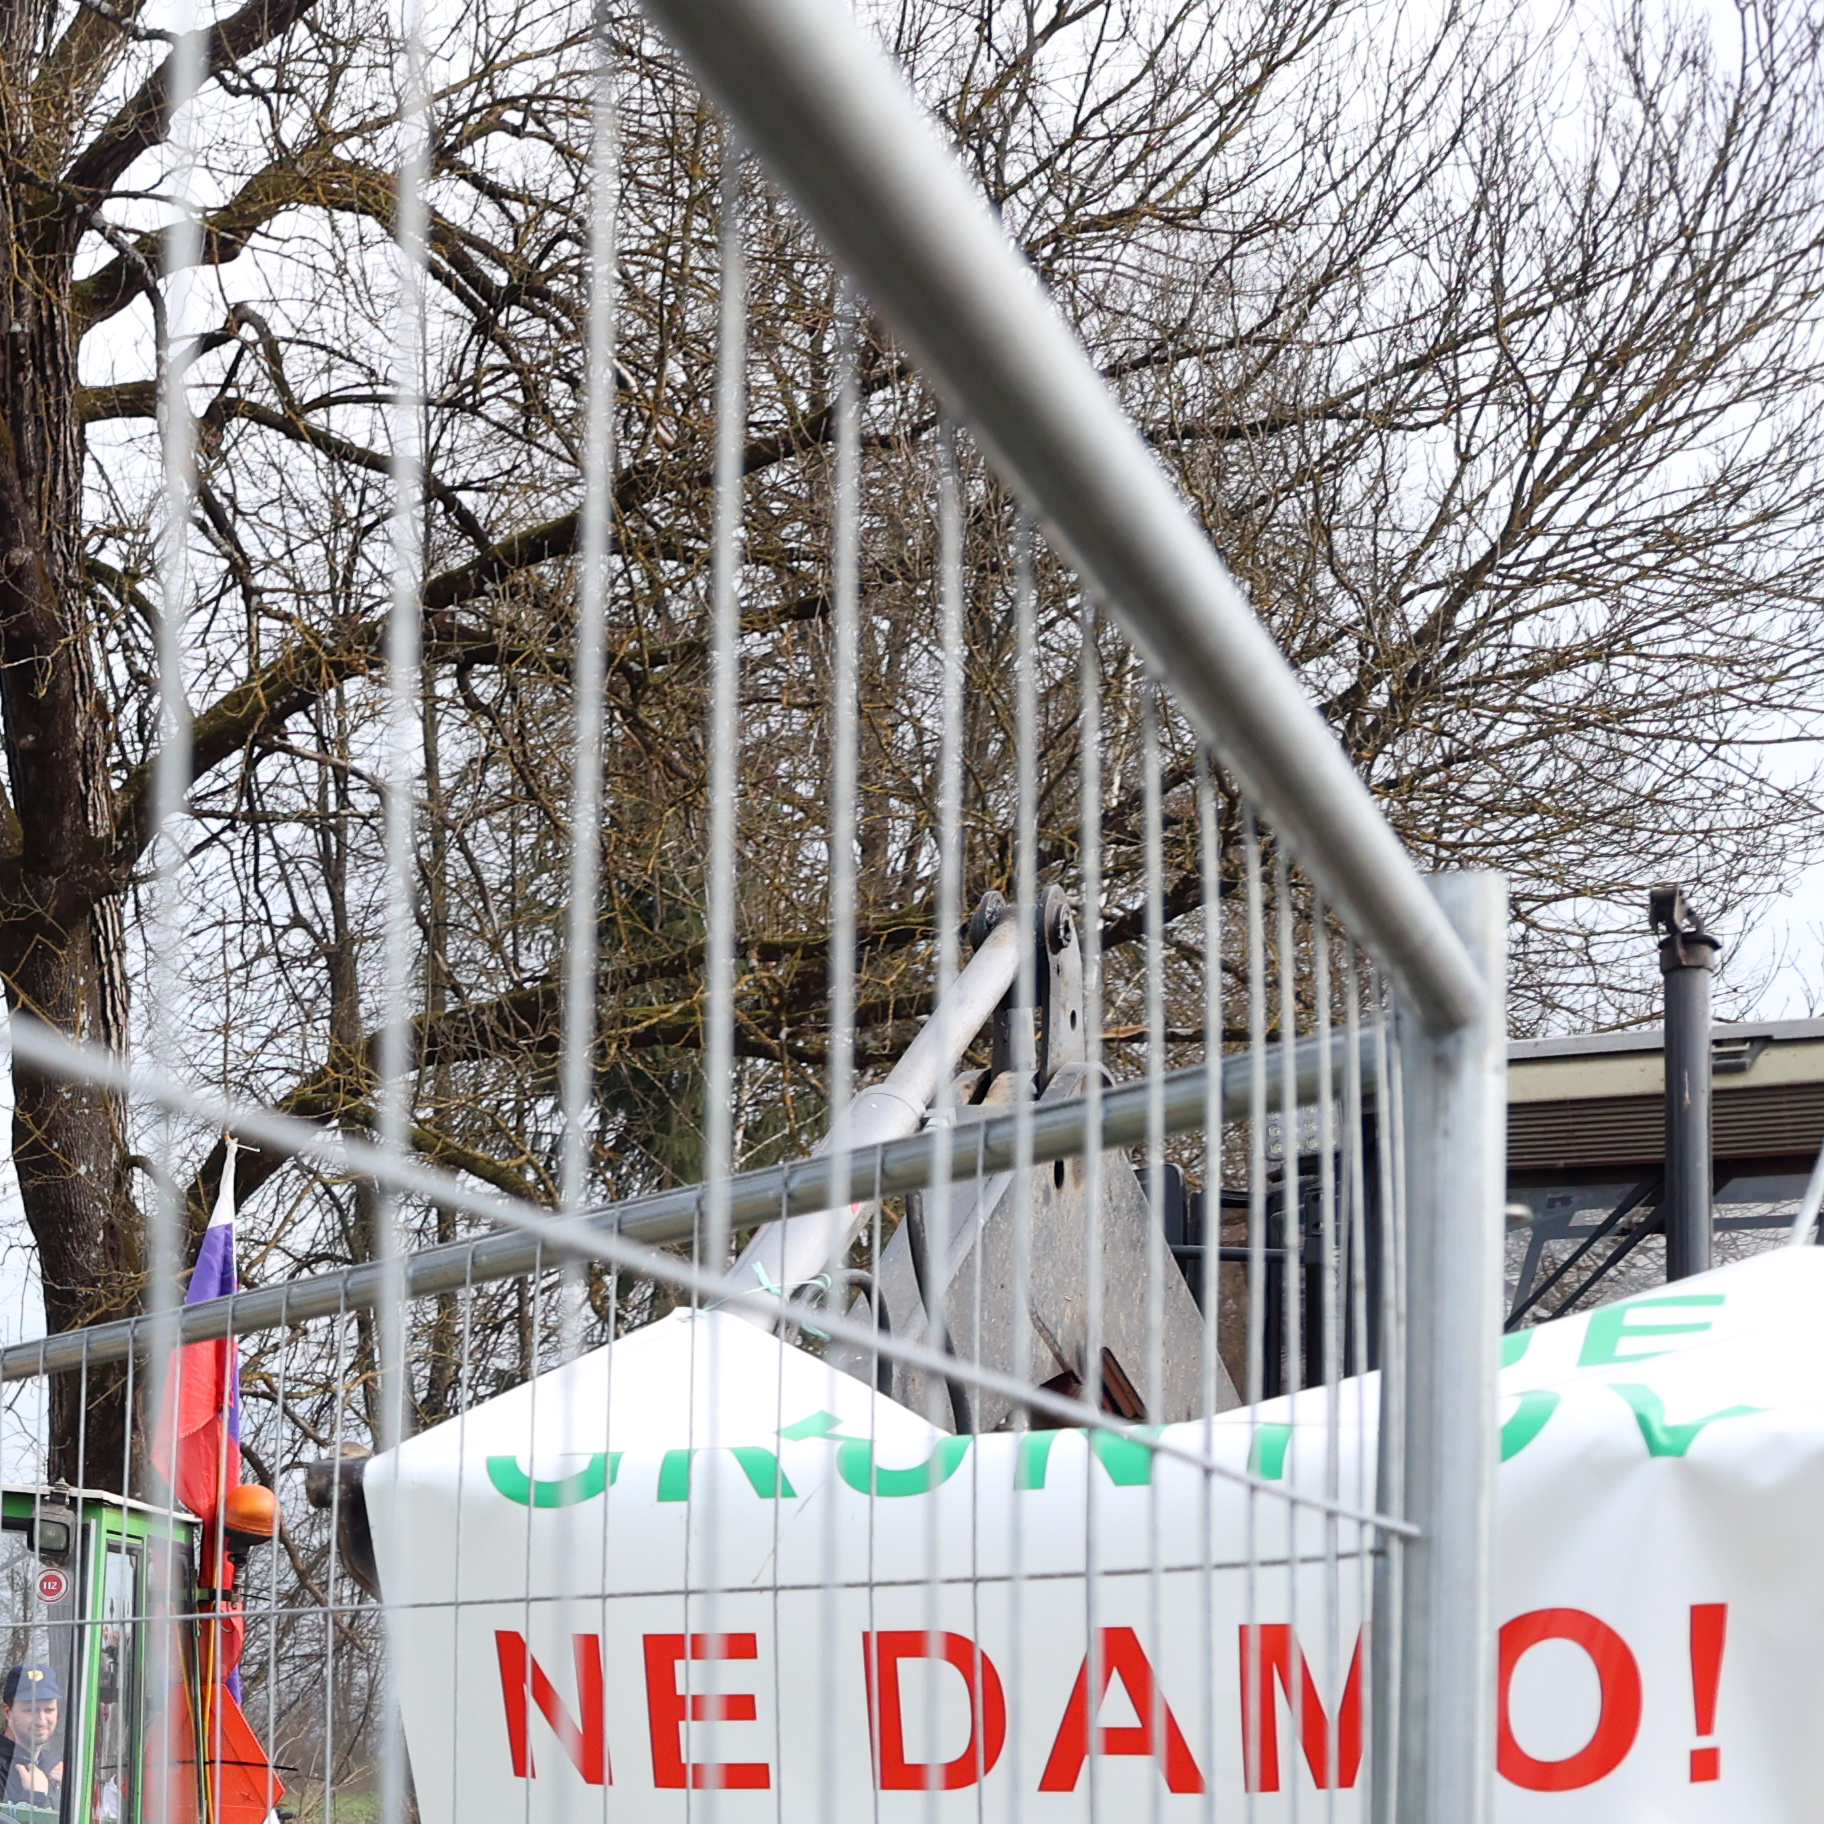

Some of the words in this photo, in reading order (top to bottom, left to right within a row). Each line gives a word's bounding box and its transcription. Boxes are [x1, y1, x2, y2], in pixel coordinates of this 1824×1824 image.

[42, 1581, 58, 1590] 112
[494, 1629, 772, 1791] NE
[861, 1602, 1729, 1795] DAMO!
